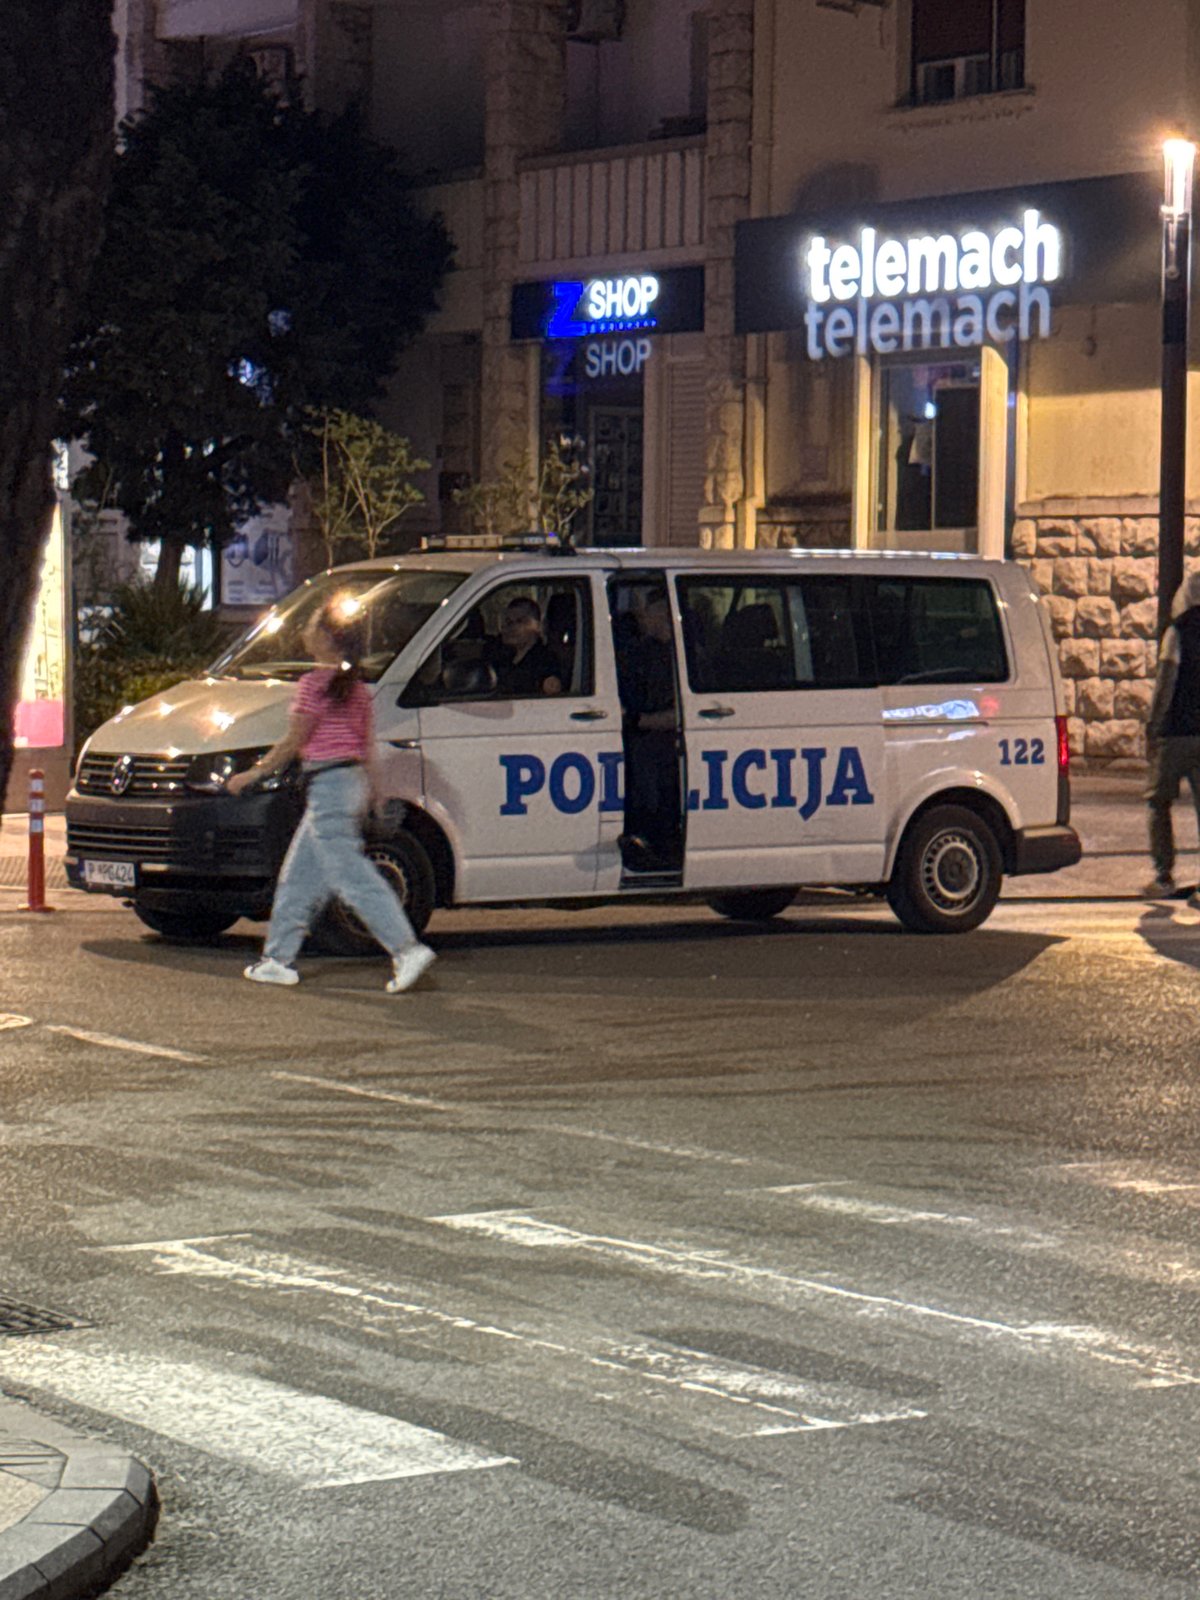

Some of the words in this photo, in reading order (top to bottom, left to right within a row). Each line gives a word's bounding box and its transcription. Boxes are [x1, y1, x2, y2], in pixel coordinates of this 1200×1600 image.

[807, 209, 1060, 303] telemach
[588, 276, 659, 319] SHOP
[804, 283, 1050, 360] telemach
[585, 338, 652, 378] SHOP
[998, 738, 1045, 765] 122
